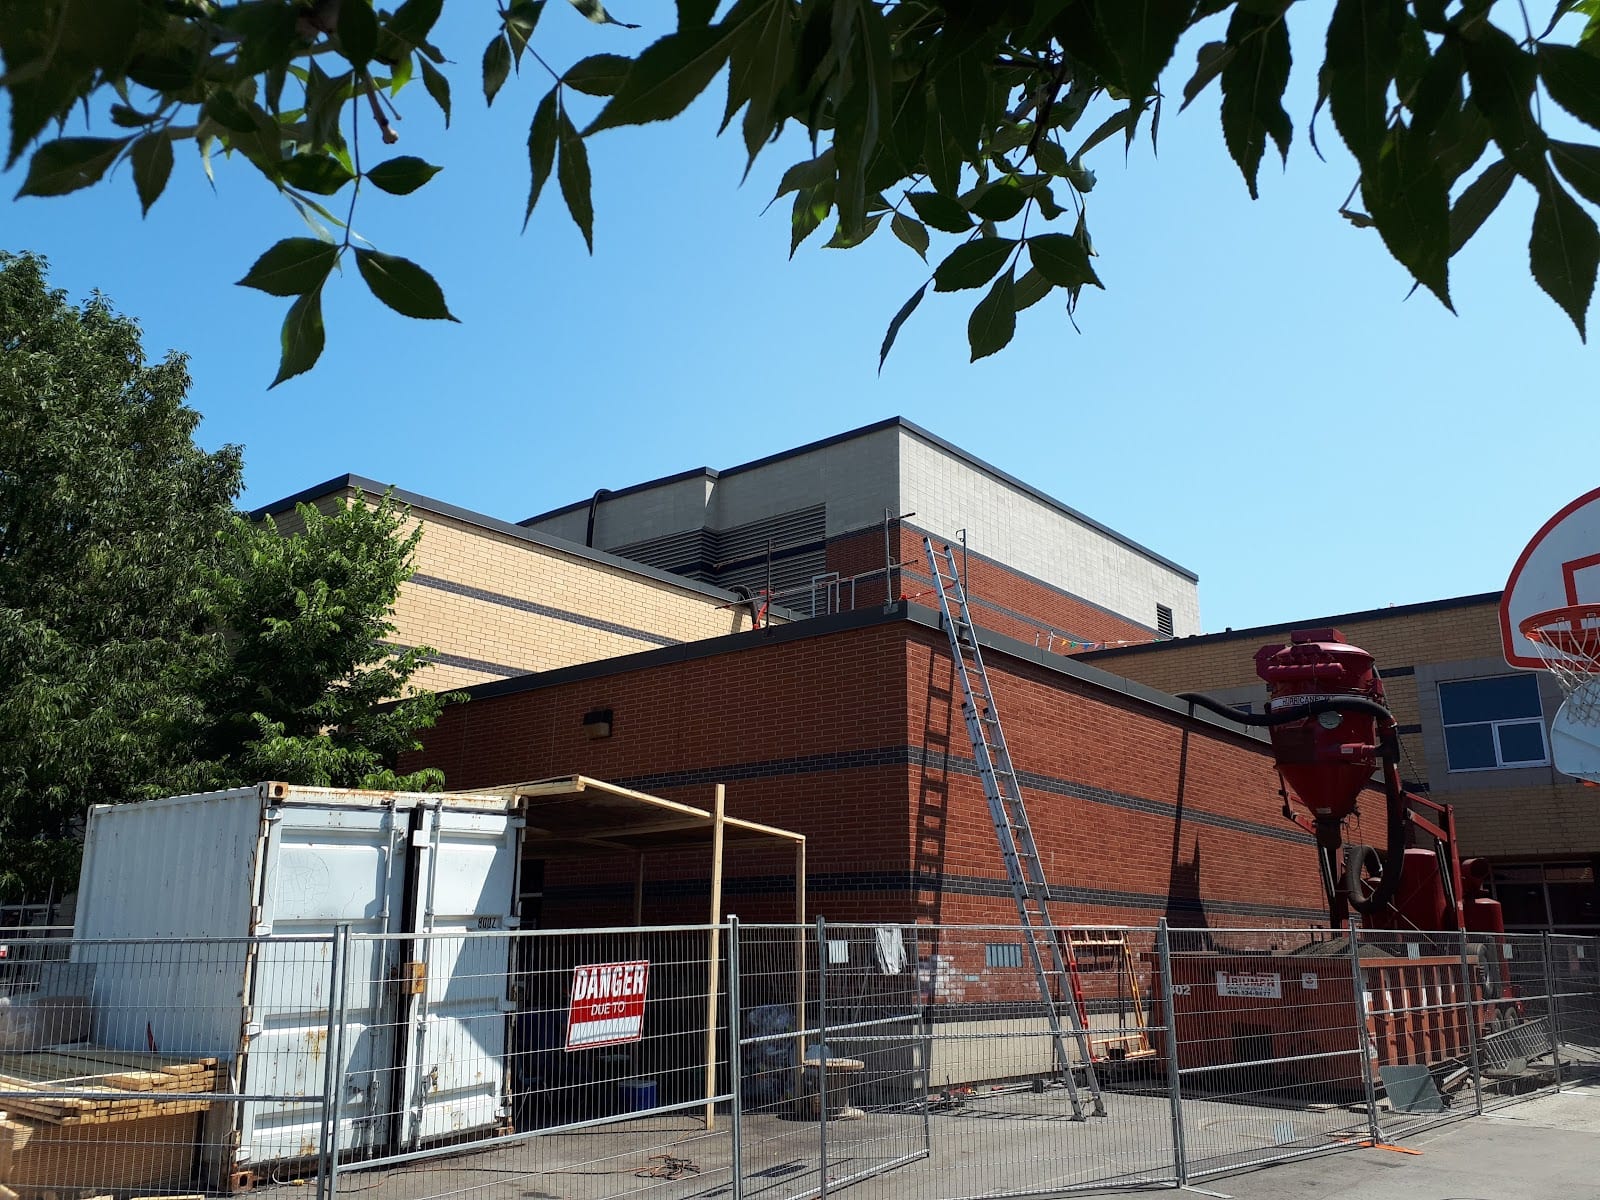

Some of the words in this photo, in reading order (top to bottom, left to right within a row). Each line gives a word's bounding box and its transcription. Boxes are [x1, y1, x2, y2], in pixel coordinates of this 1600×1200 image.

[574, 965, 645, 1000] DANGER
[1222, 973, 1275, 988] TRIUMPH
[591, 1003, 610, 1016] DUE
[612, 1001, 625, 1013] TO
